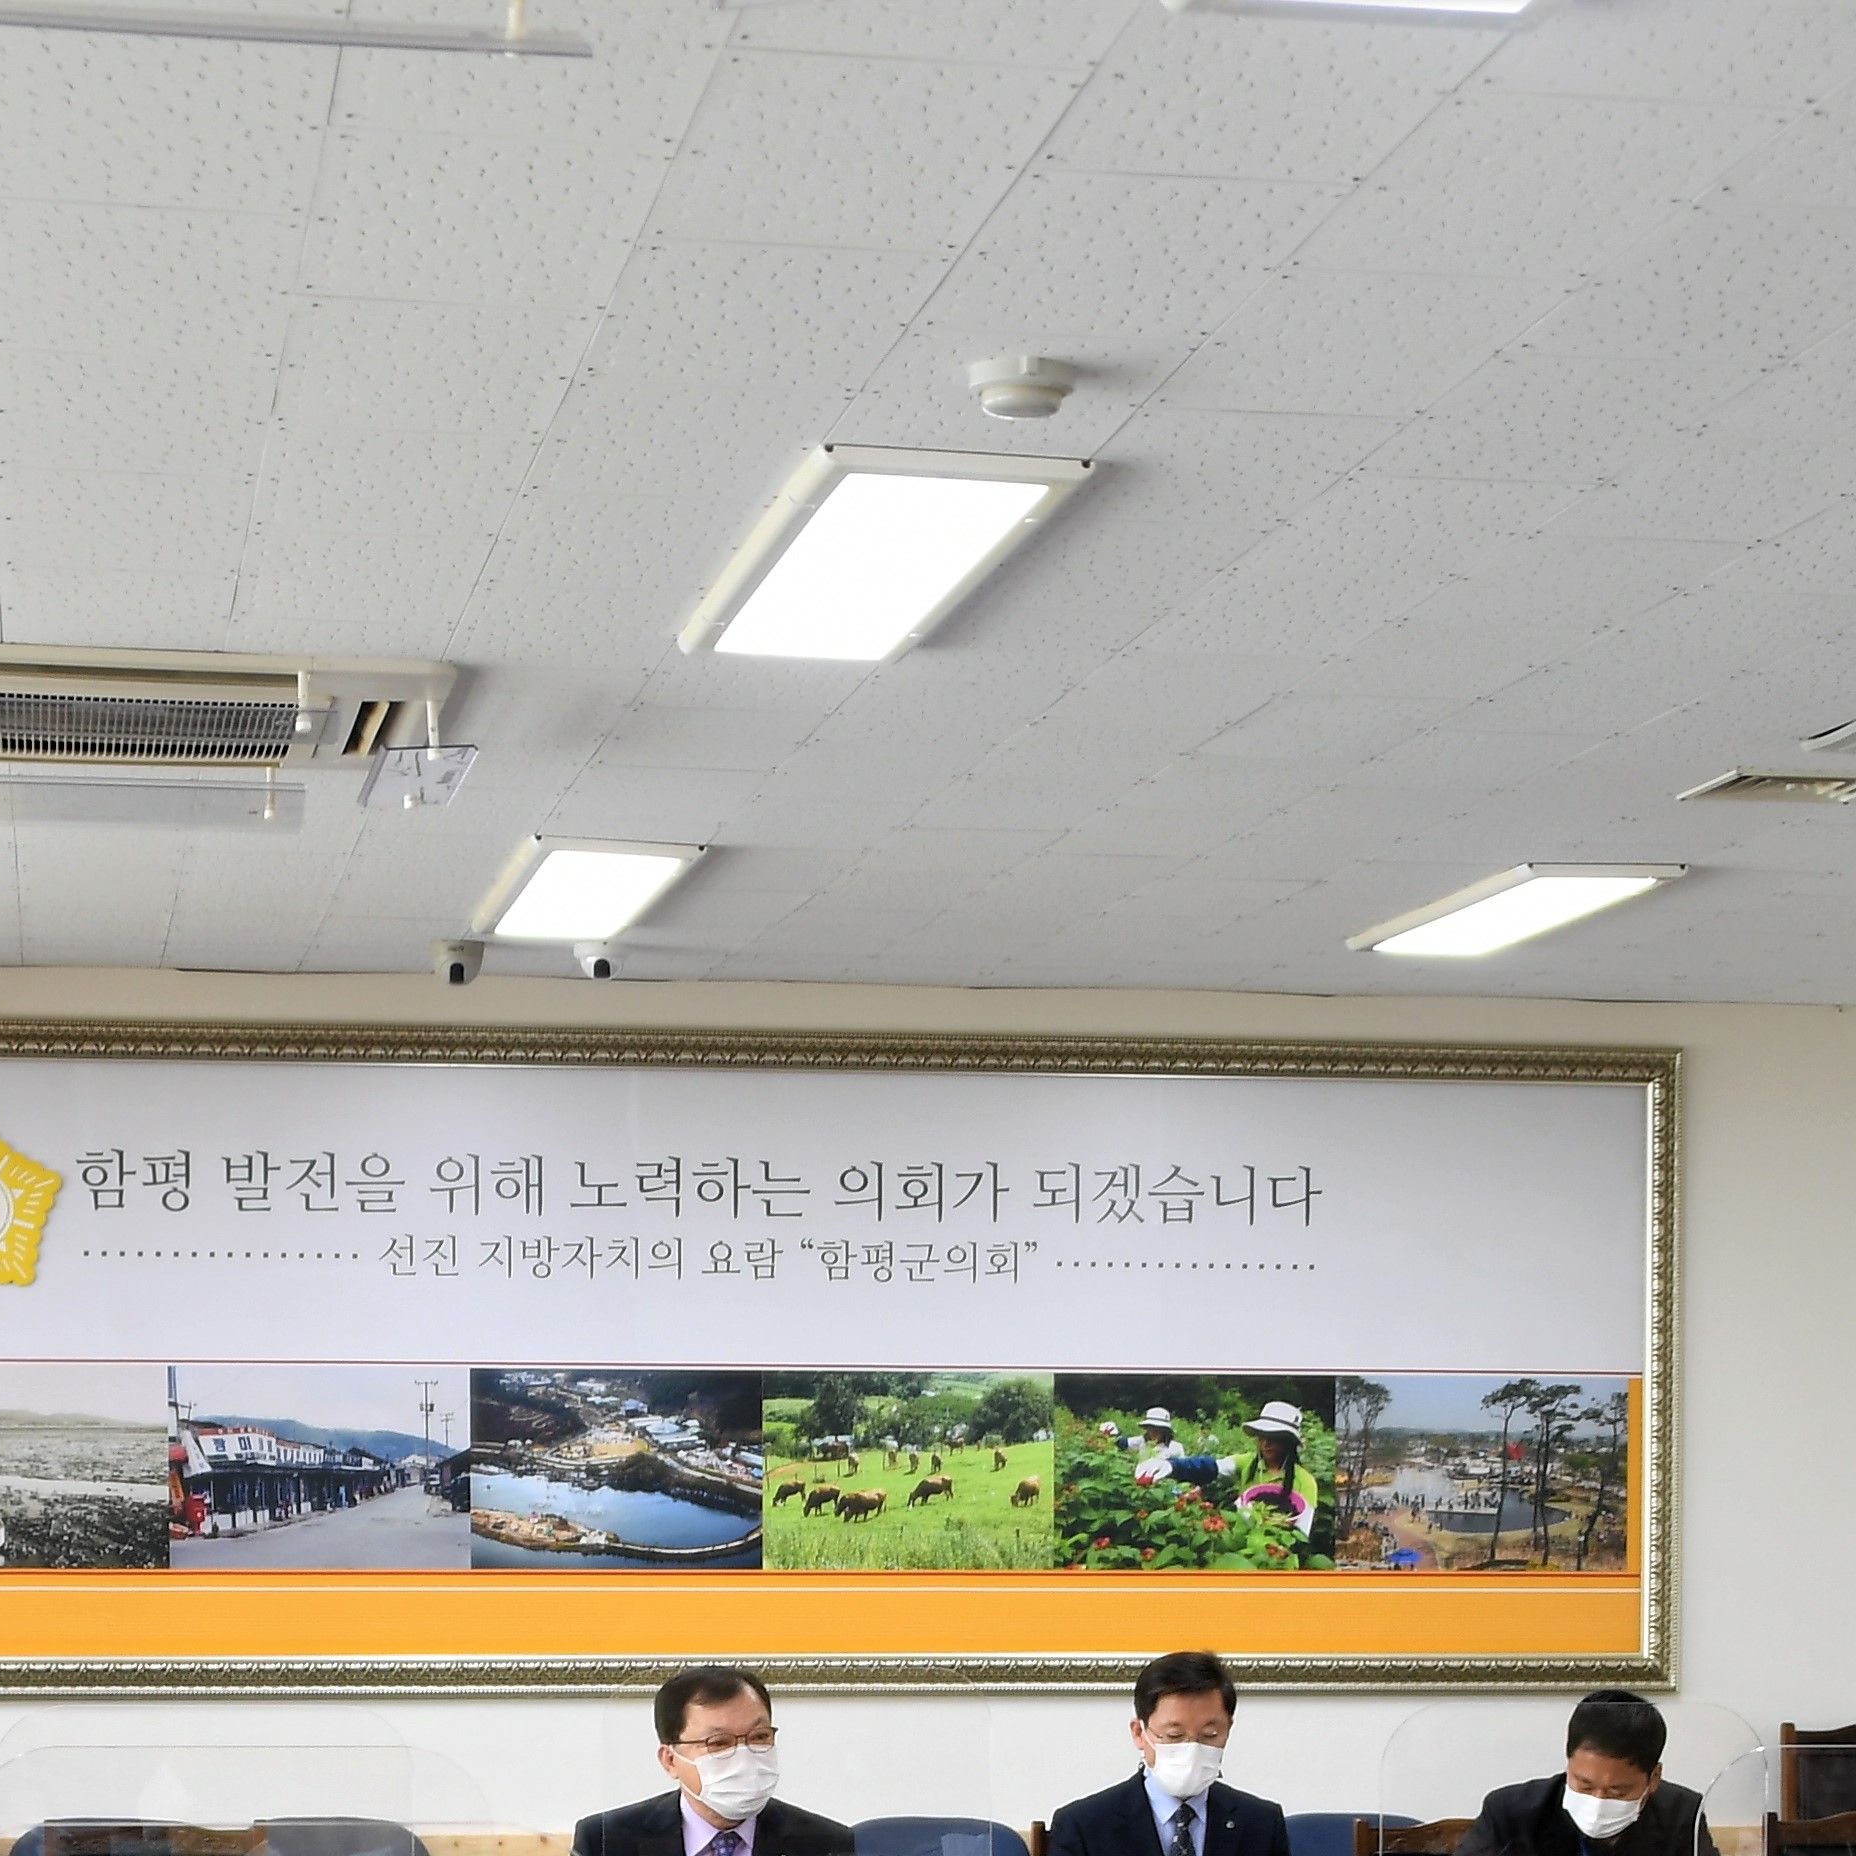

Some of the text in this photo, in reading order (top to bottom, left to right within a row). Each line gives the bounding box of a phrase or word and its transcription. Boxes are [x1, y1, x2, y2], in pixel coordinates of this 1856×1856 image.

[75, 1148, 1323, 1227] 함평 발전을 위해 노력하는 의회가 되겠습니다
[378, 1233, 460, 1277] 선진
[478, 1234, 683, 1281] 지방자치의
[701, 1237, 784, 1282] 요람
